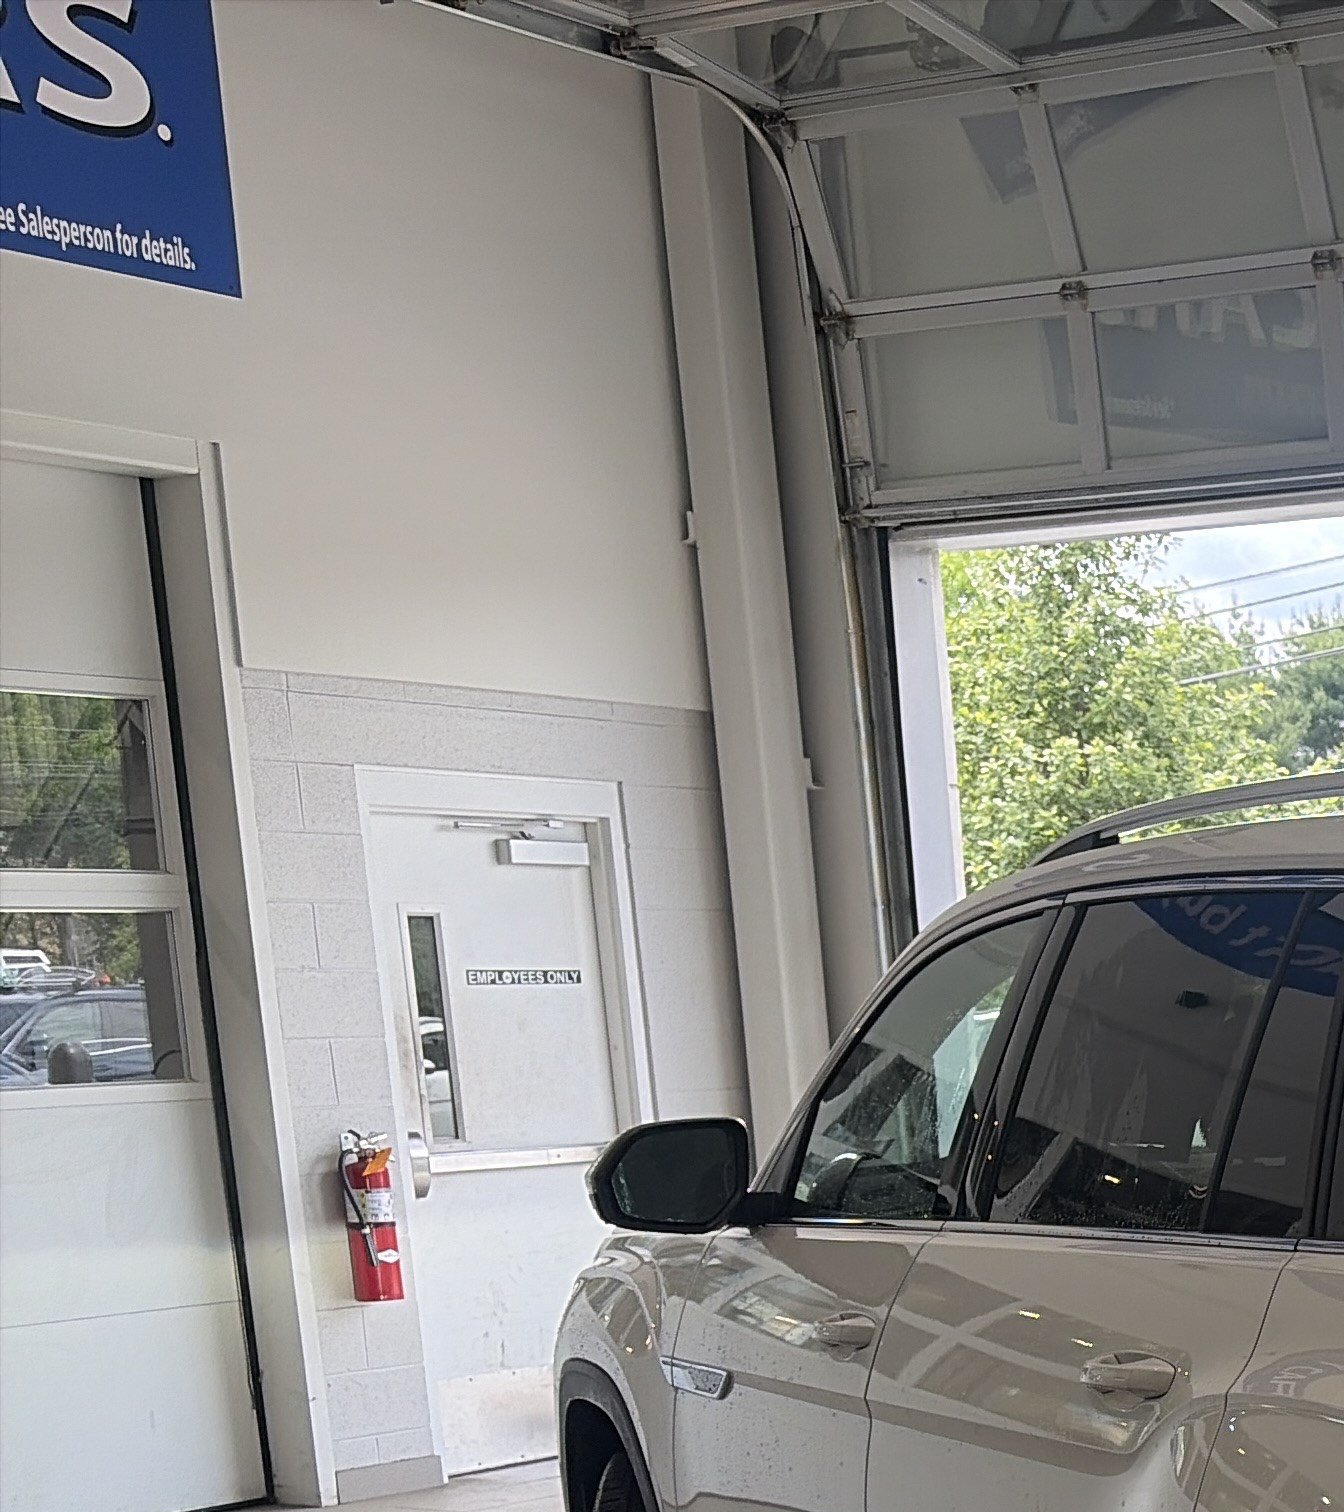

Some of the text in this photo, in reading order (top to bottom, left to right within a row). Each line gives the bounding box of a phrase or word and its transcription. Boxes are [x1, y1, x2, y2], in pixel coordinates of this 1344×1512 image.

[0, 0, 173, 145] S.
[18, 203, 114, 252] Salesperson
[115, 223, 138, 258] for
[142, 230, 196, 271] details.
[468, 971, 579, 985] EMPLOYEES ONLY
